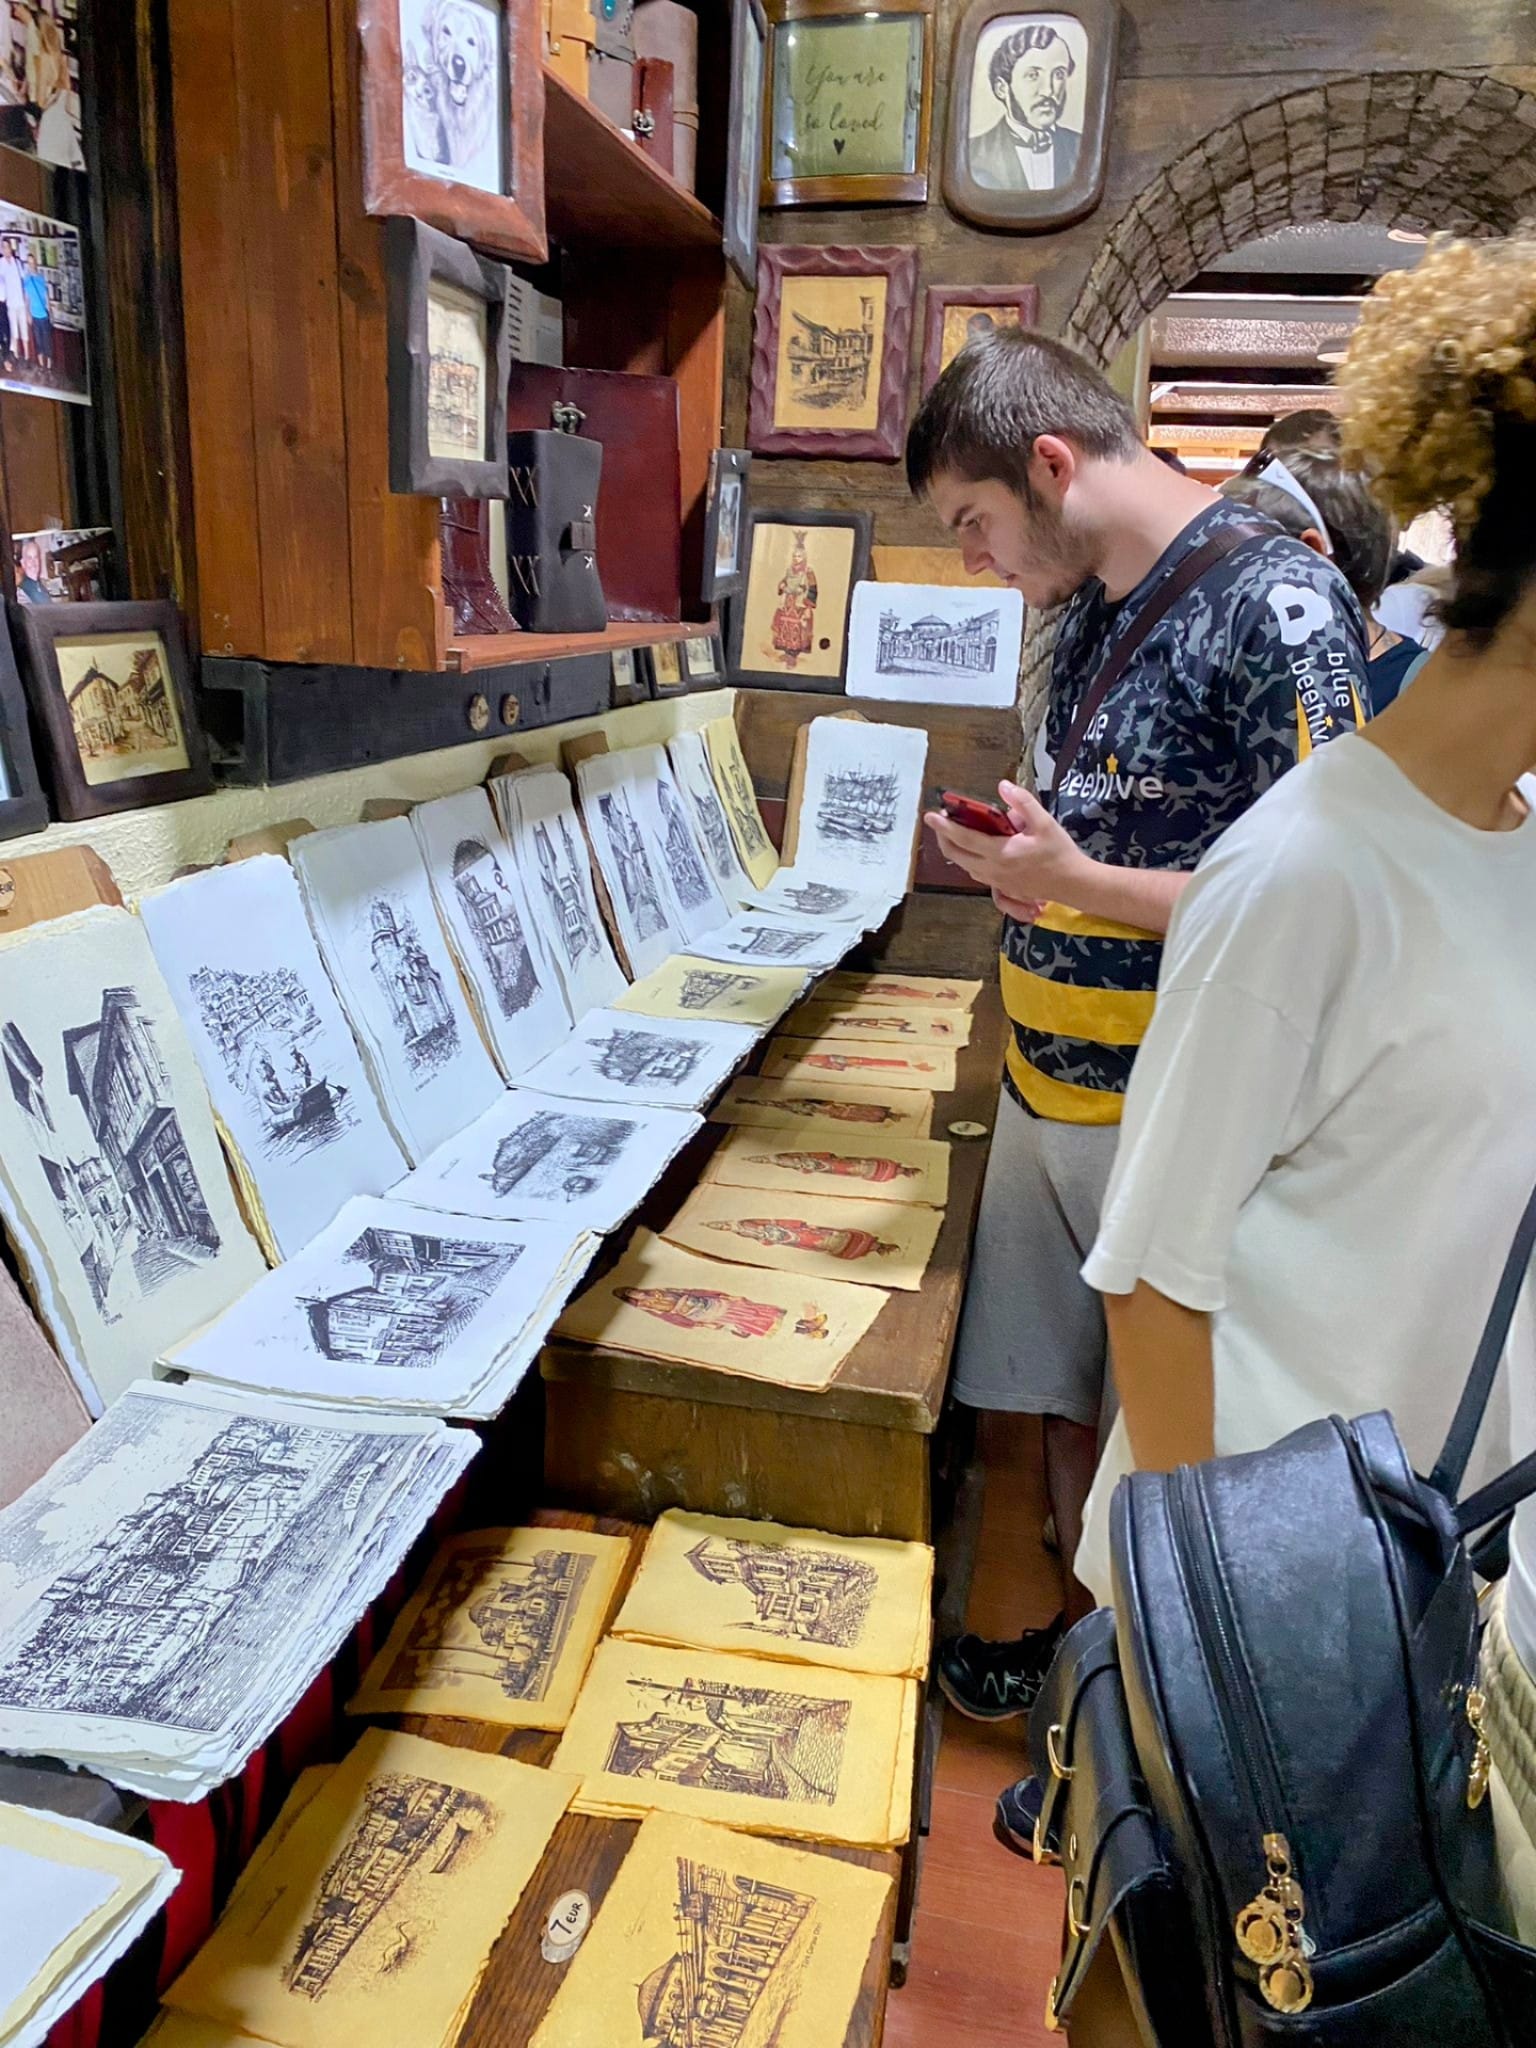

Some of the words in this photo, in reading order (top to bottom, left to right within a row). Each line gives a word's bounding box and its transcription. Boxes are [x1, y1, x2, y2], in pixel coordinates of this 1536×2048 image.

[1290, 655, 1330, 741] beehiv
[1327, 652, 1351, 708] blue
[550, 1918, 573, 1935] 7
[565, 1902, 584, 1924] EUR
